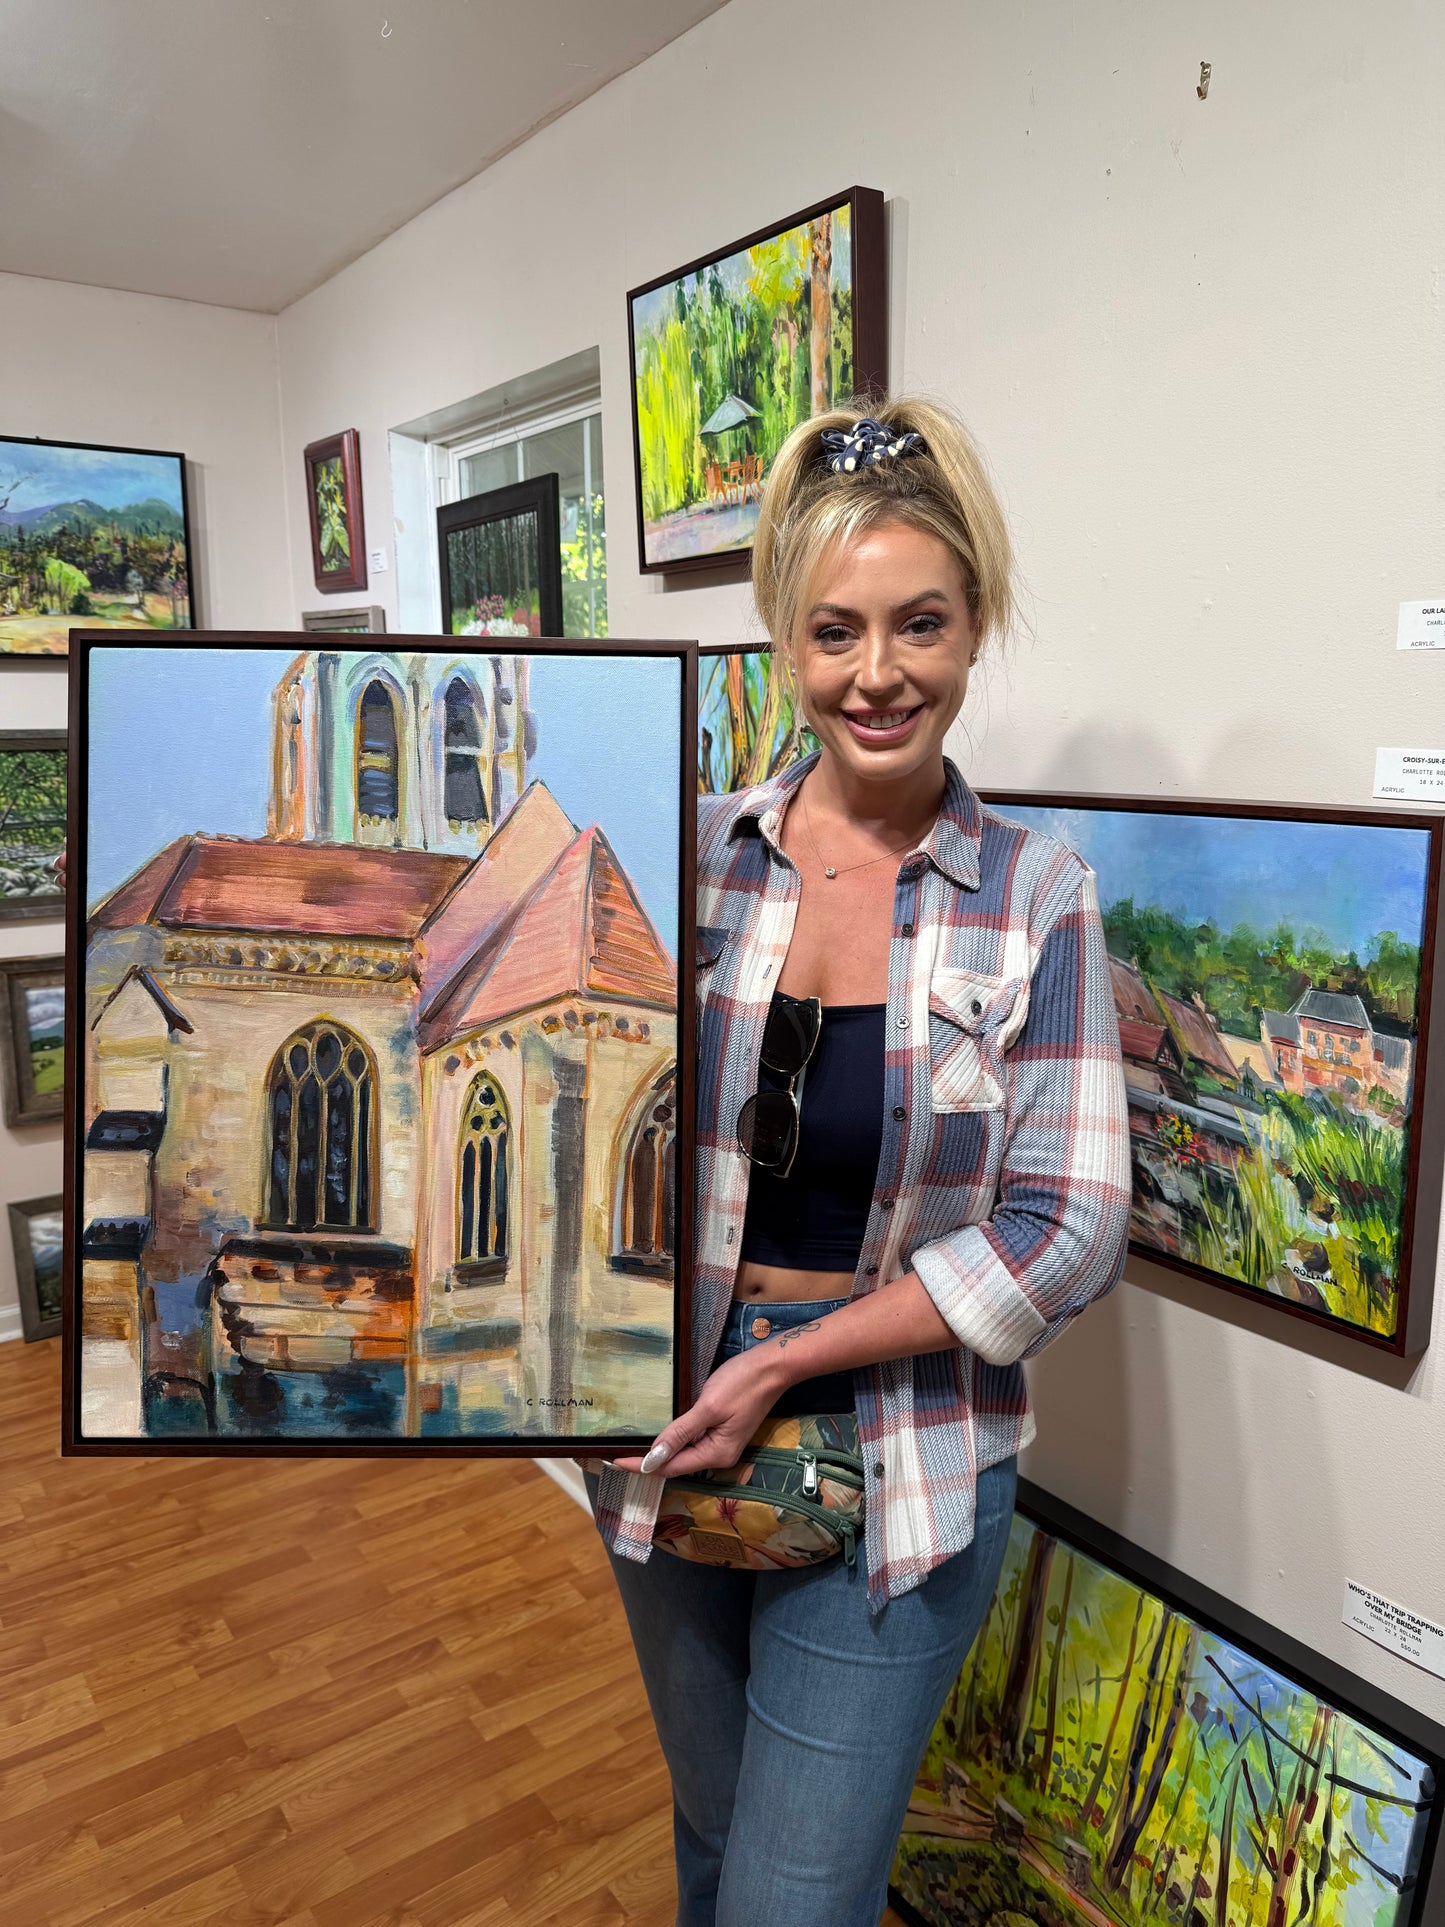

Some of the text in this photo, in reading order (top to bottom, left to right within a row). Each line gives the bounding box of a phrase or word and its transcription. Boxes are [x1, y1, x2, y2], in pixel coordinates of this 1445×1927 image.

[1293, 1266, 1338, 1286] ROLLMAN
[526, 1397, 594, 1407] C ROLLMAN
[1348, 1582, 1444, 1637] WHO'S THAT TRIP TRAPPING
[1364, 1600, 1422, 1636] OVER MY BRIDGE
[1352, 1616, 1375, 1632] ACRYLIC
[1369, 1612, 1422, 1643] CHARLOTTE ROLLMAN
